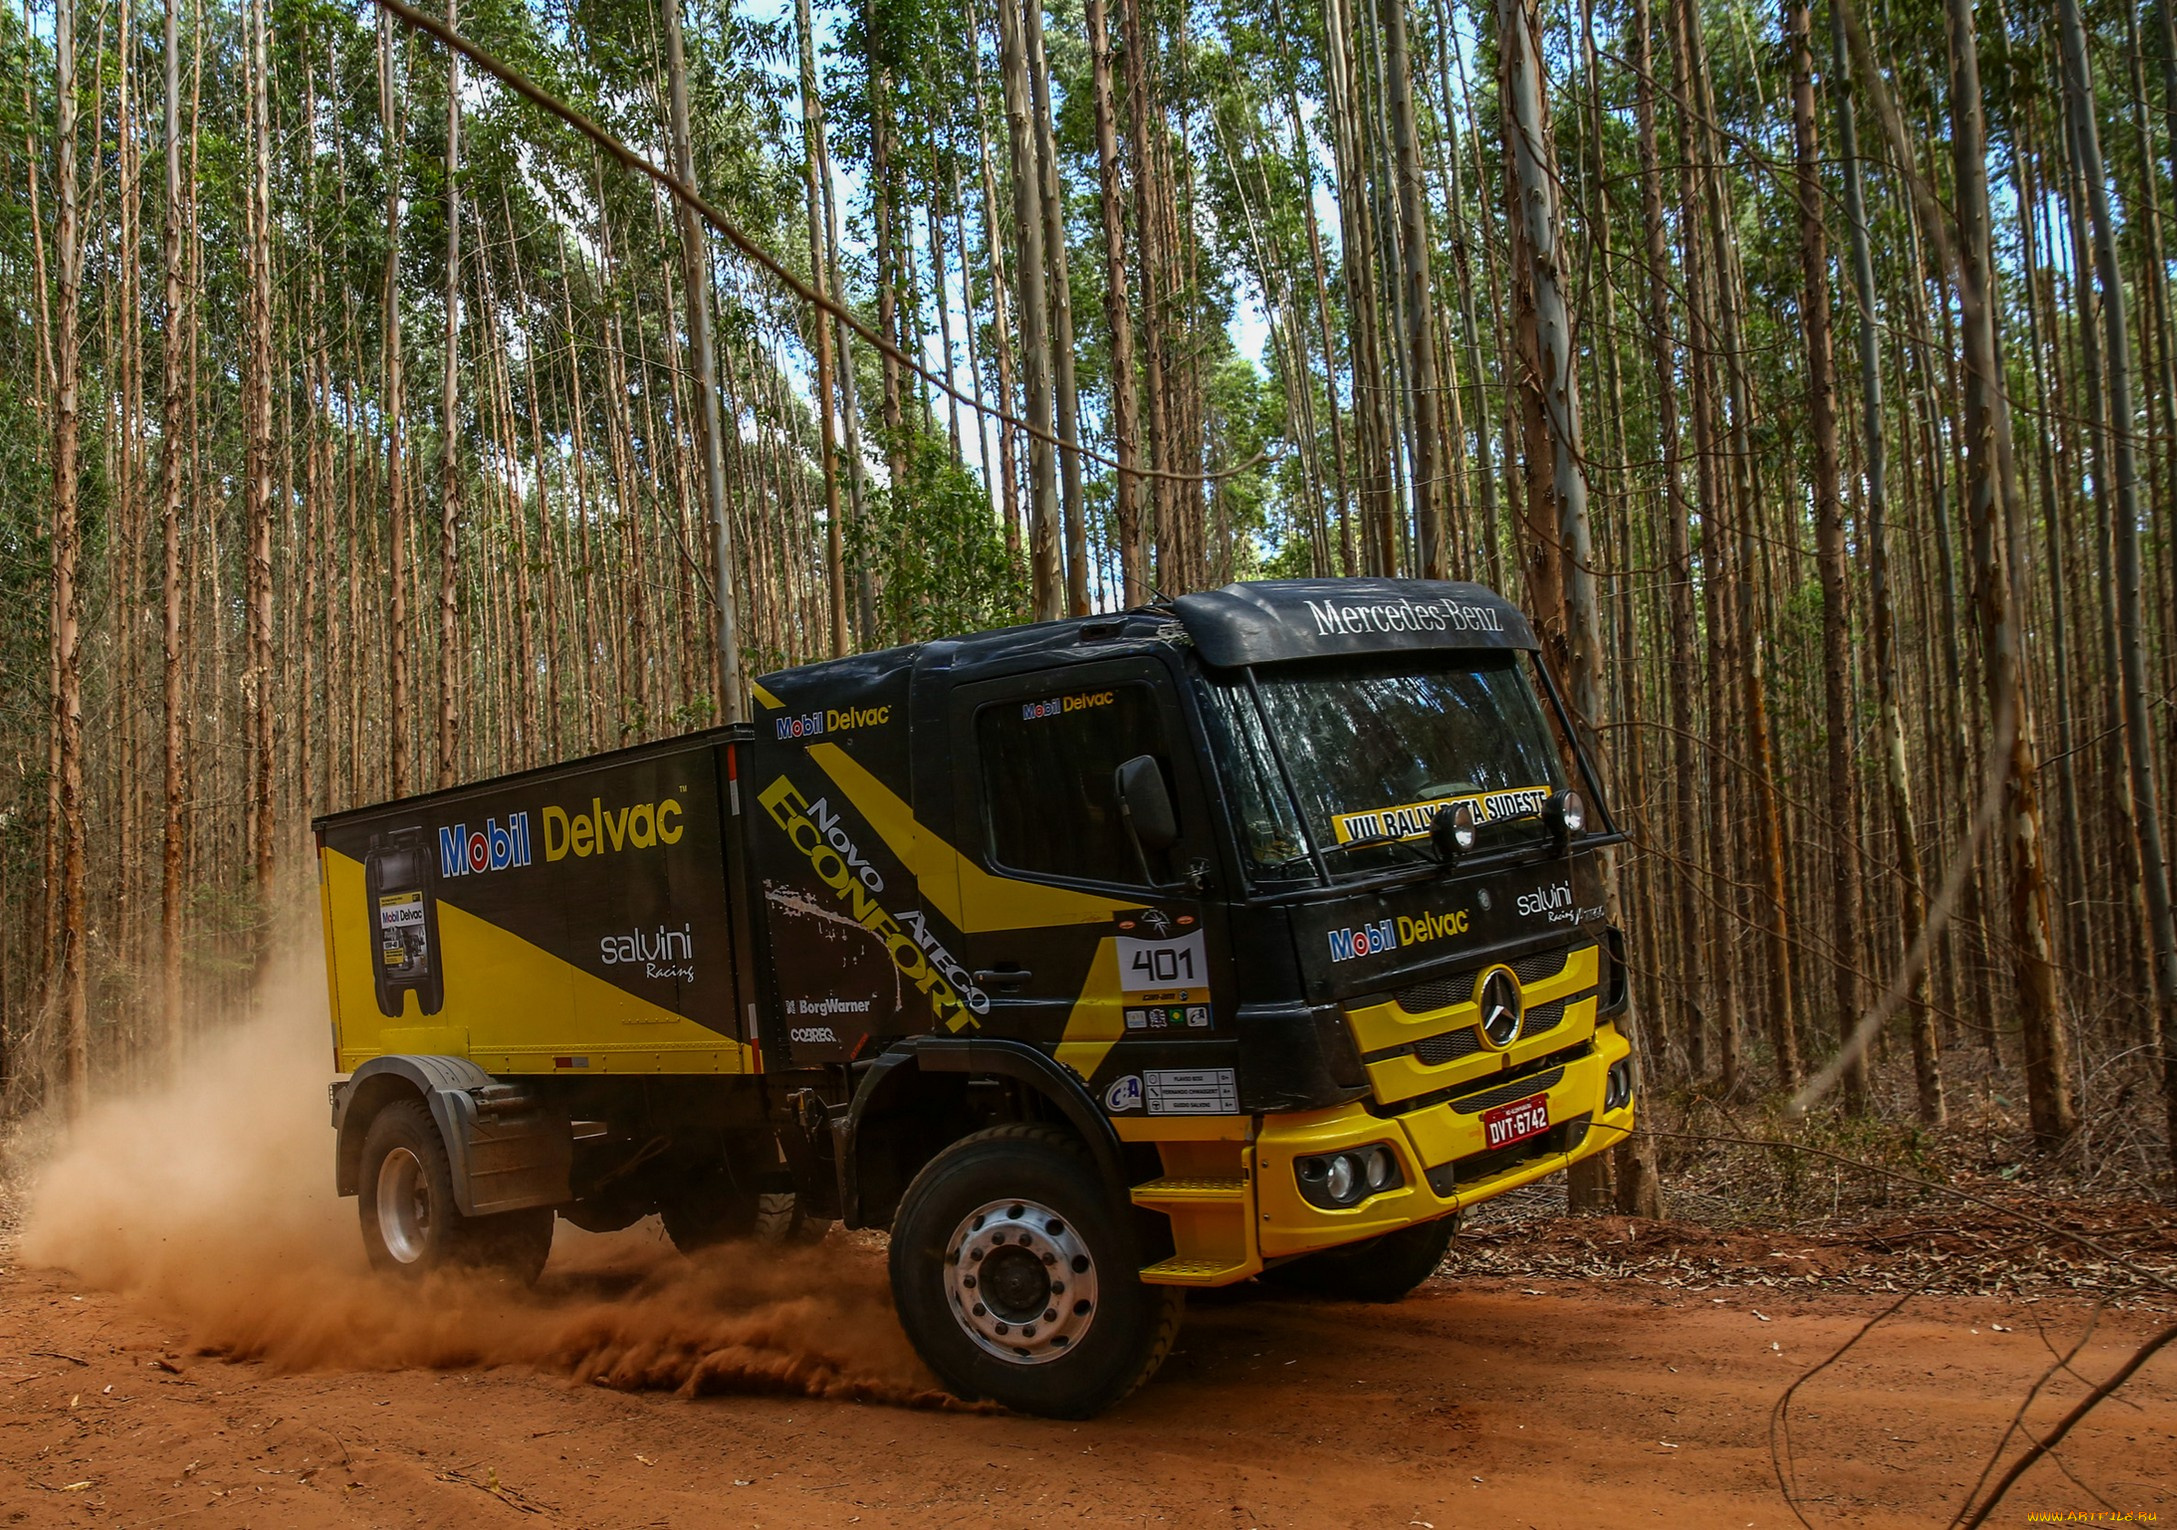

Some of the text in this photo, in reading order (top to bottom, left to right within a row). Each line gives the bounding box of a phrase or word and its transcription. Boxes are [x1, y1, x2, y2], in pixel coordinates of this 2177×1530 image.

[1304, 598, 1504, 636] Mercedes-Benz
[776, 706, 889, 740] Mobil Delvac
[1022, 691, 1114, 720] Mobil Delvac
[438, 811, 532, 879] Mobil
[542, 797, 684, 862] Delvac
[1382, 806, 1434, 838] RALLY
[807, 797, 884, 893] NOVO
[383, 909, 422, 923] Mobil Delvac
[757, 774, 981, 1034] ECONFORT
[1517, 880, 1573, 916] salvini
[601, 923, 692, 965] salvini
[1328, 911, 1470, 962] Mobil Delvac
[646, 962, 695, 983] Racing
[1132, 948, 1194, 982] 401
[800, 998, 870, 1016] BorgWarner
[1489, 1107, 1548, 1144] DVT-6742
